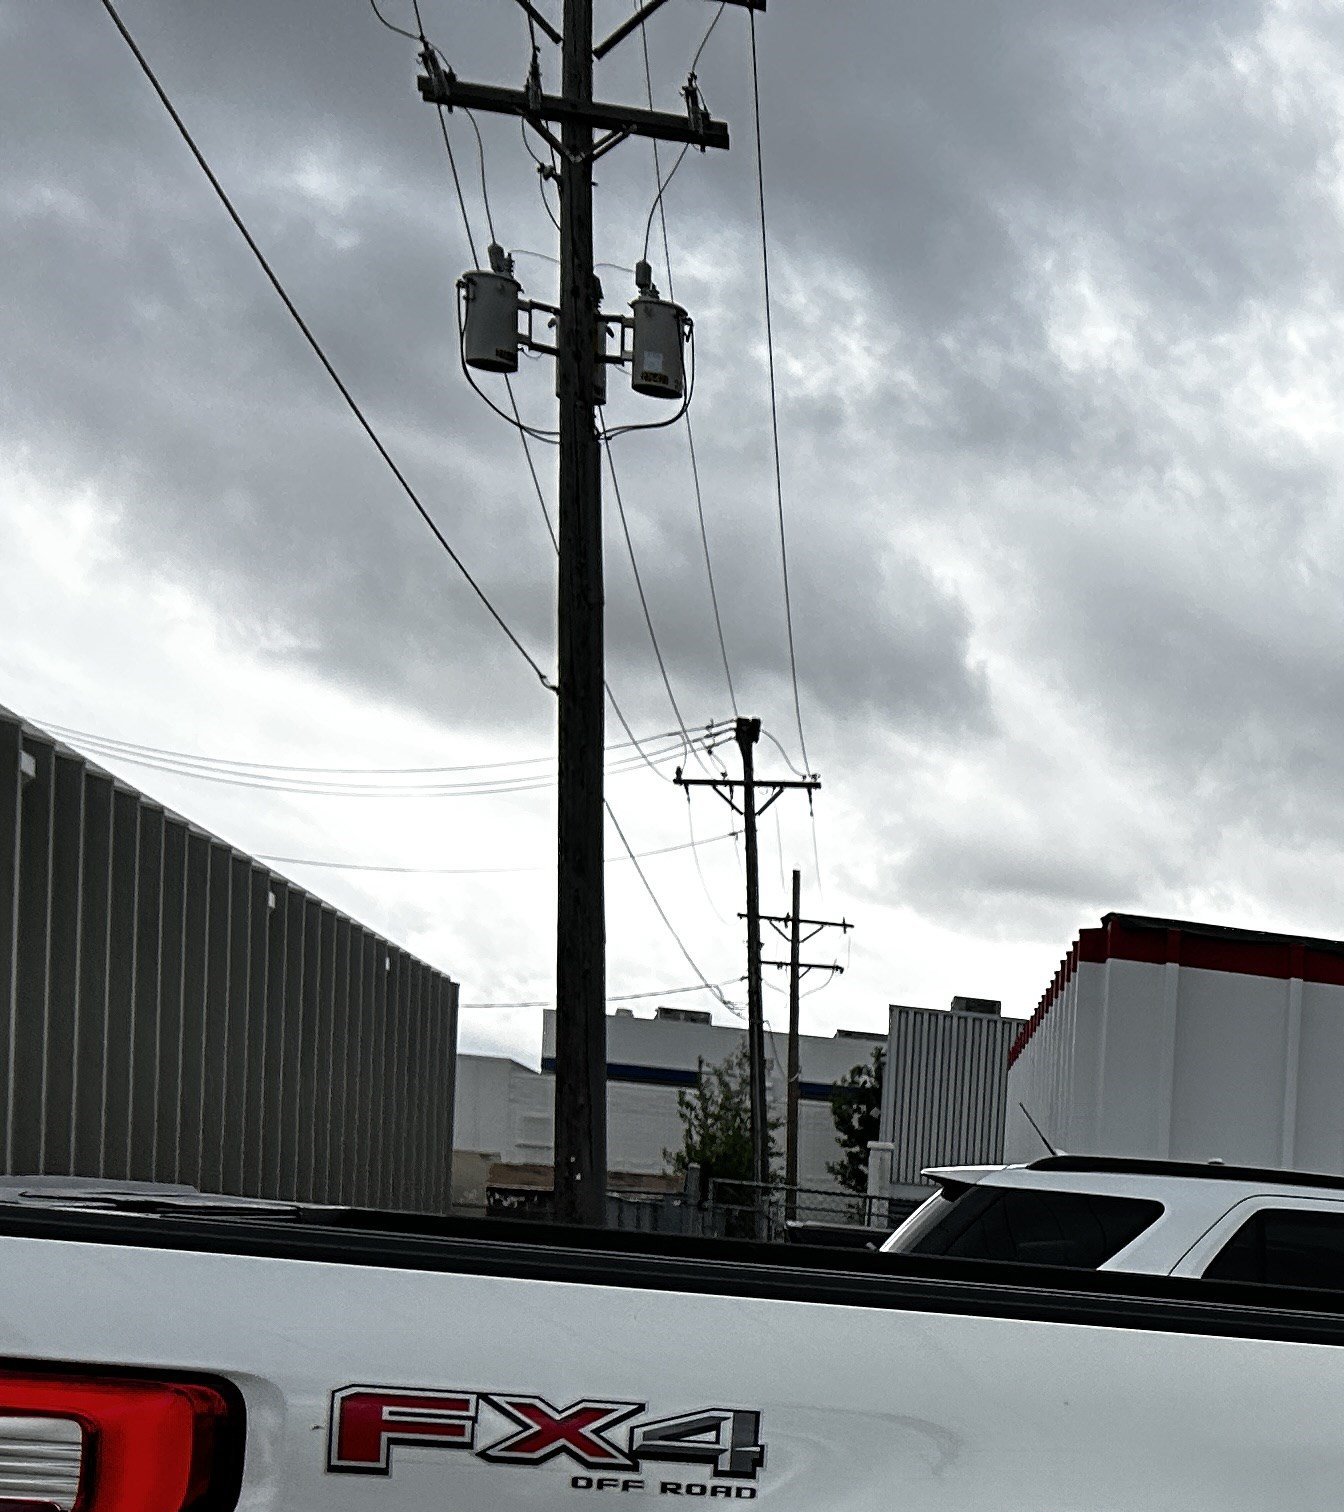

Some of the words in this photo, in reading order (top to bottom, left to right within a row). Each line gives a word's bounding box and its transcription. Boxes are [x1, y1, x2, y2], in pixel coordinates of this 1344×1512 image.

[326, 1384, 765, 1478] FX4
[571, 1475, 645, 1492] OFF
[660, 1481, 757, 1500] ROAD
